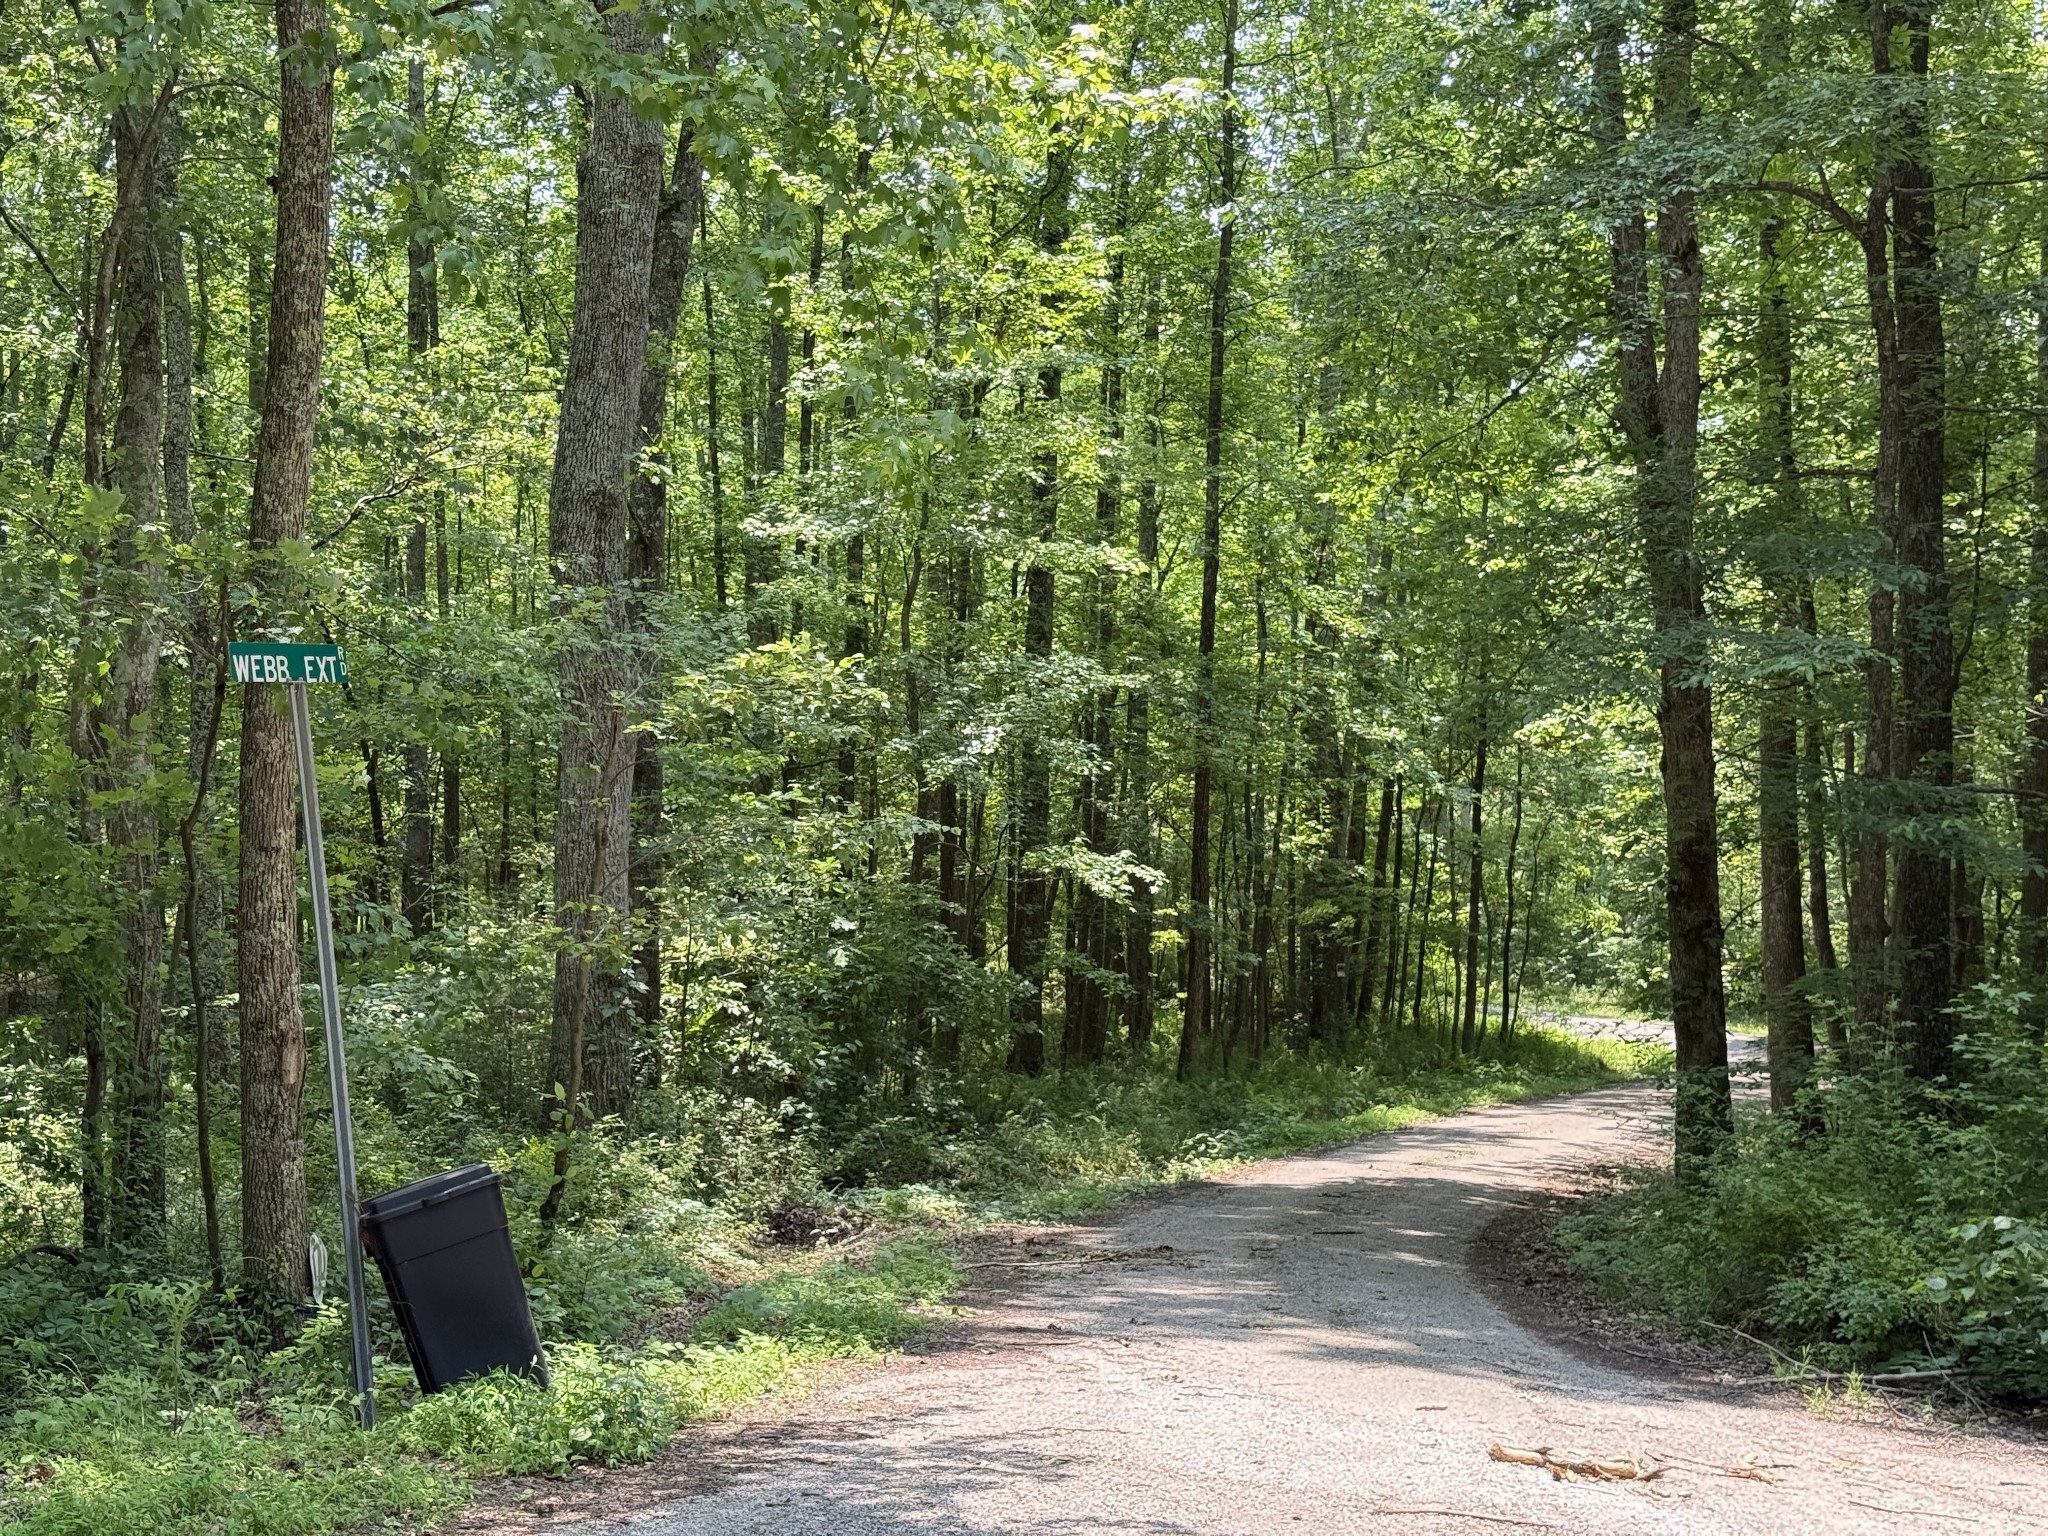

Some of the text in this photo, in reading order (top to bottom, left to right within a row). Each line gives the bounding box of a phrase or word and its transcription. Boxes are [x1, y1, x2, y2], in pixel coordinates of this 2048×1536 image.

[232, 646, 347, 683] WEBB EXT RD
